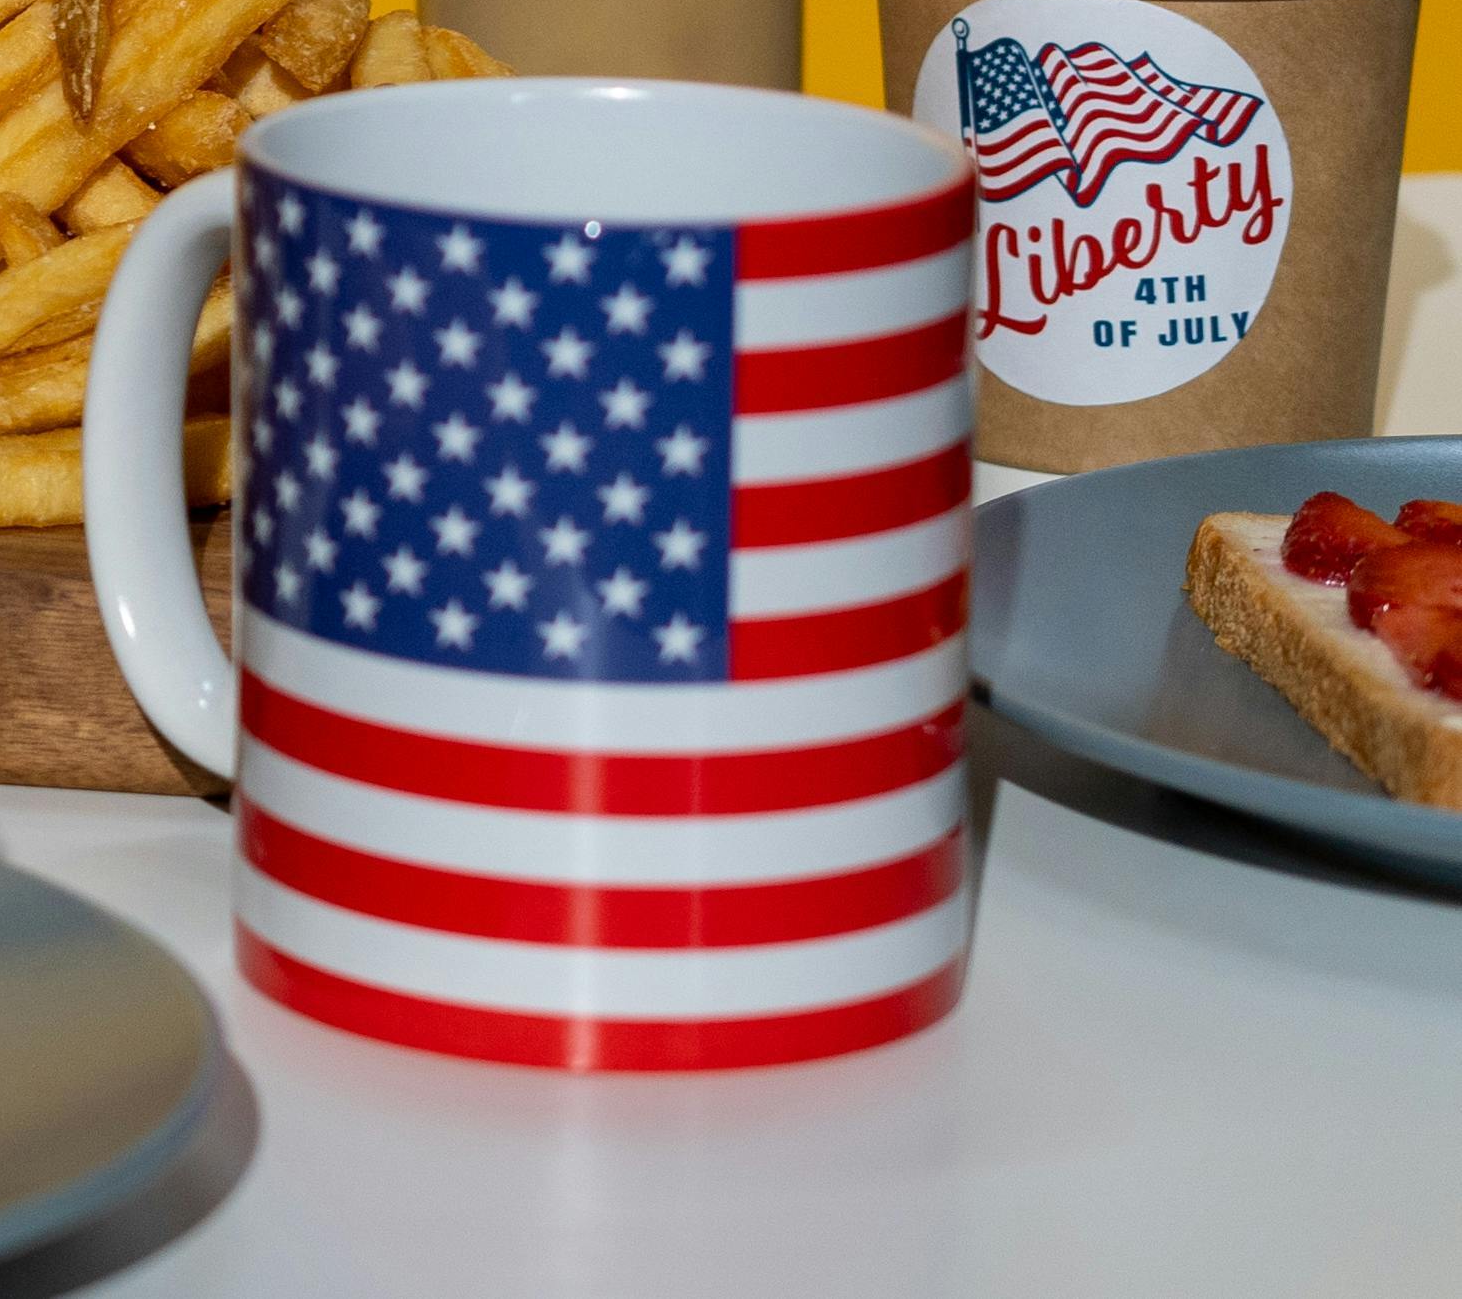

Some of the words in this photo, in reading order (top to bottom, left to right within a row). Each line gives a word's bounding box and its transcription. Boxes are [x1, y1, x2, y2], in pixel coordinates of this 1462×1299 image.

[977, 144, 1284, 341] Liberty
[1134, 274, 1206, 305] 4TH
[1093, 320, 1137, 348] OF
[1158, 311, 1250, 347] JULY
